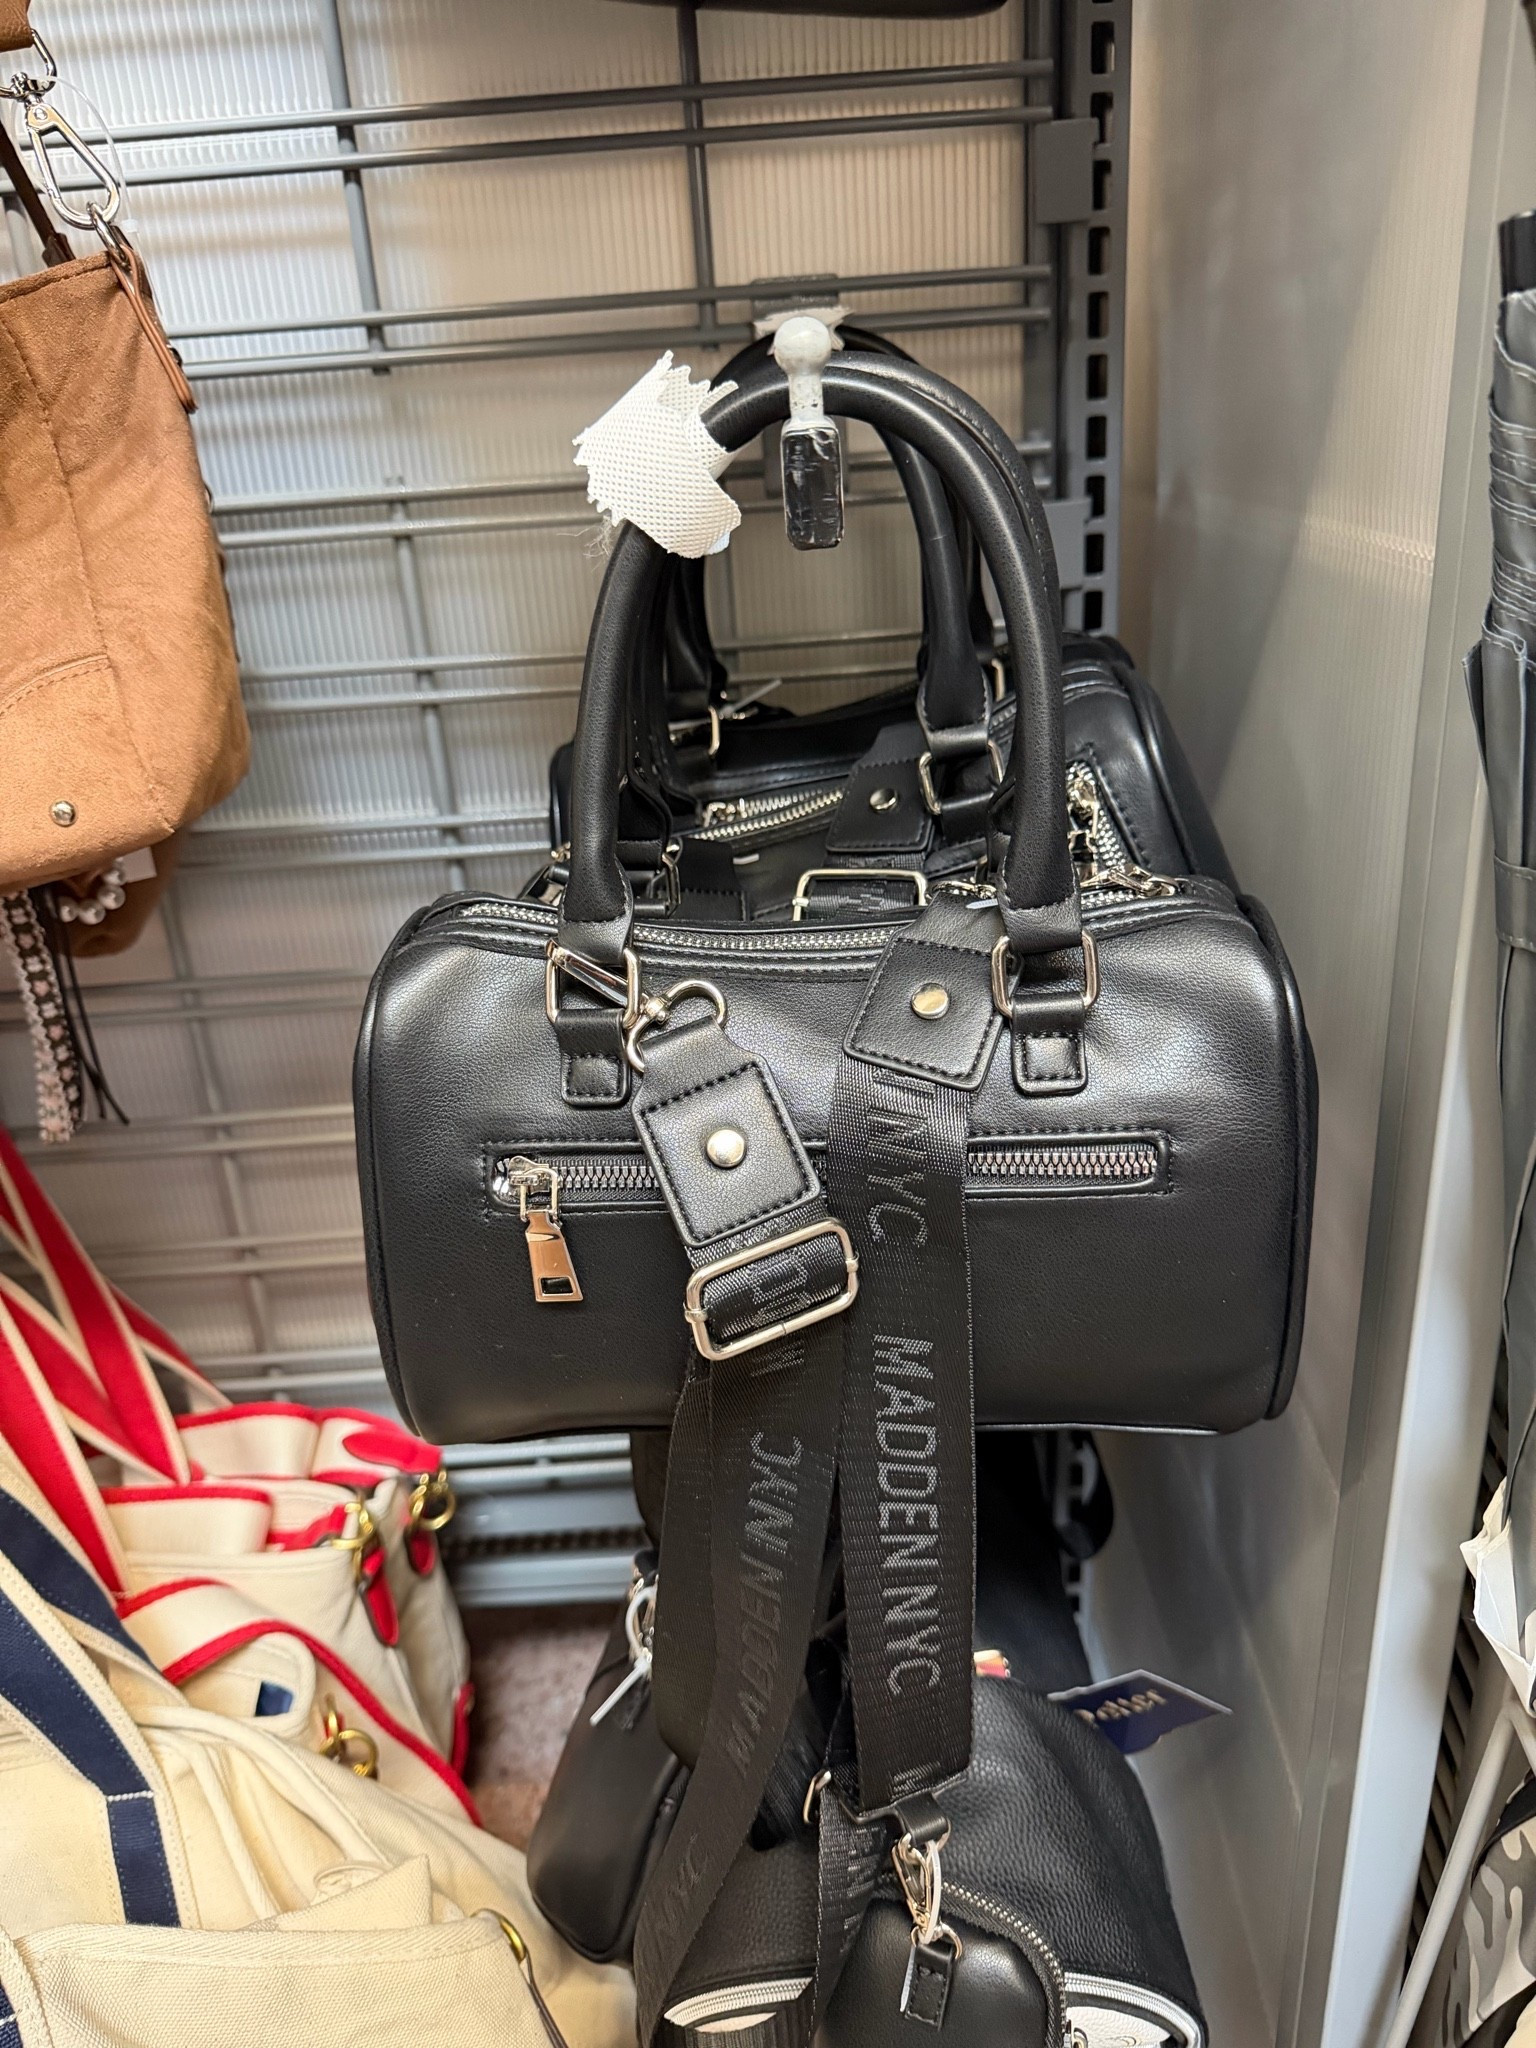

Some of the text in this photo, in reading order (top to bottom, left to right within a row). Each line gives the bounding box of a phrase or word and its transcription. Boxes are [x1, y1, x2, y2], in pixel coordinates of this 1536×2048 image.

[866, 1105, 929, 1247] NYC
[744, 1429, 804, 1556] NYC
[873, 1333, 939, 1569] MADDEN
[726, 1550, 784, 1779] MADDEN
[882, 1584, 941, 1695] NYC
